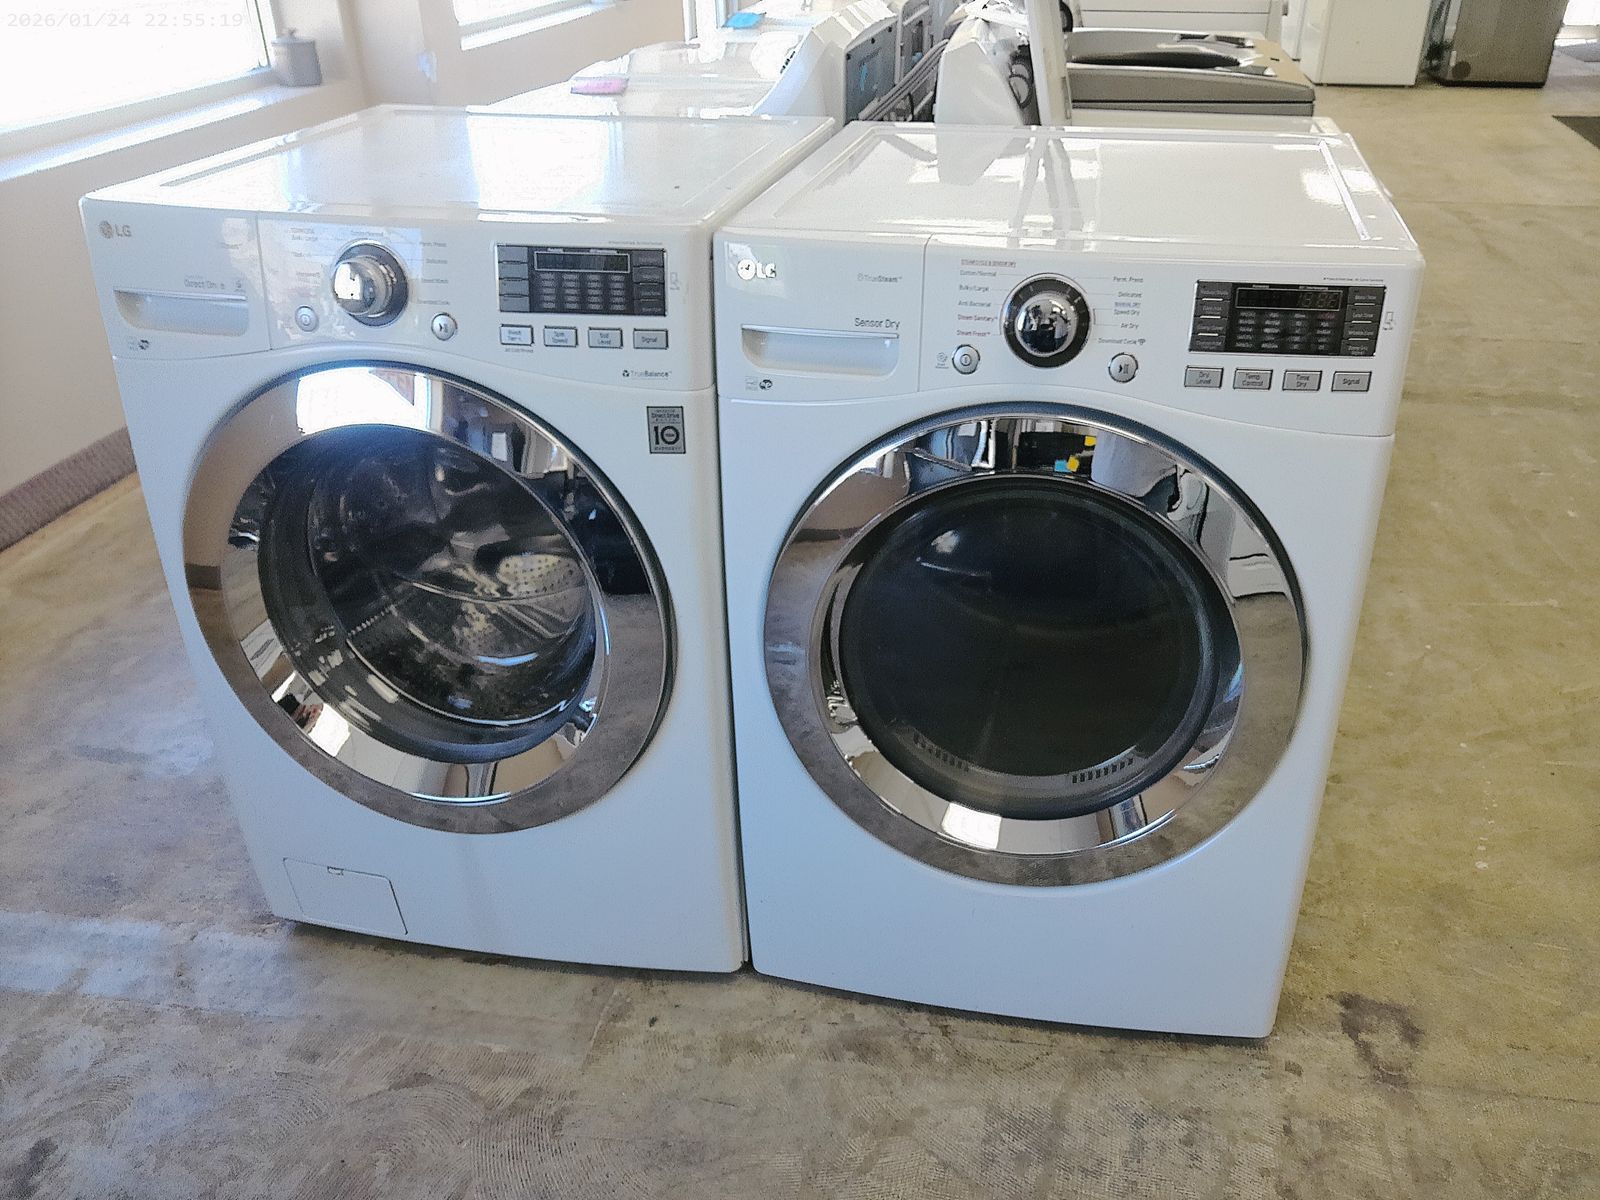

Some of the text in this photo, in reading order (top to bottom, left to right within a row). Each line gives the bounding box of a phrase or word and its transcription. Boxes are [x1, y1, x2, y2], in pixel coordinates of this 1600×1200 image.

[115, 223, 132, 237] LG
[757, 262, 777, 279] LG
[854, 317, 901, 331] Sensor Dry
[1342, 378, 1361, 386] Signal
